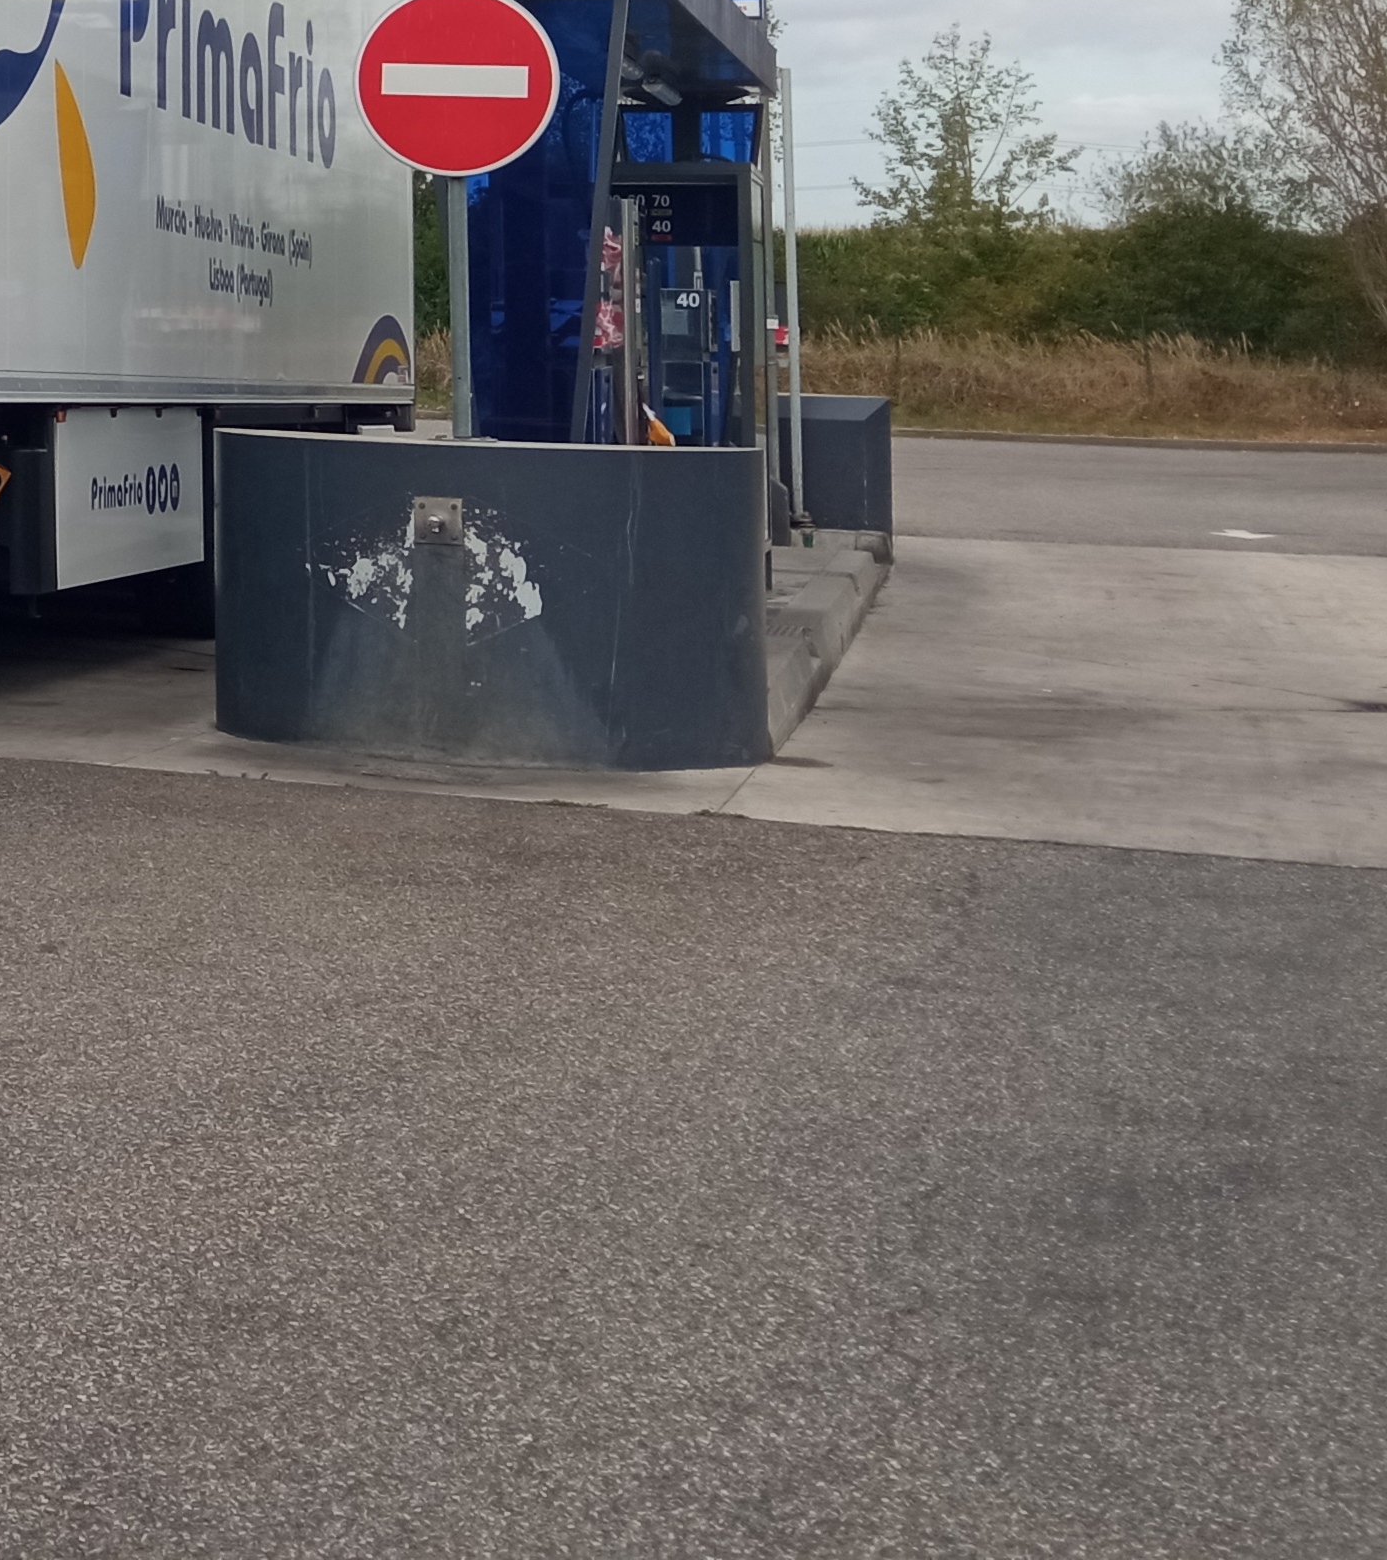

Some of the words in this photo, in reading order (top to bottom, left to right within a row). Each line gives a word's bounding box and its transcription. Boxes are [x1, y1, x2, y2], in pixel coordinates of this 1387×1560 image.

[651, 194, 670, 207] 70
[155, 194, 187, 236] Murcia
[194, 204, 223, 243] Huelva
[229, 213, 255, 250] Vitoria
[261, 221, 286, 257] Girona
[288, 228, 312, 270] (Spain)
[651, 220, 671, 233] 40
[208, 257, 235, 293] Lisboa
[236, 263, 273, 308] (Portugal)
[676, 292, 700, 308] 40
